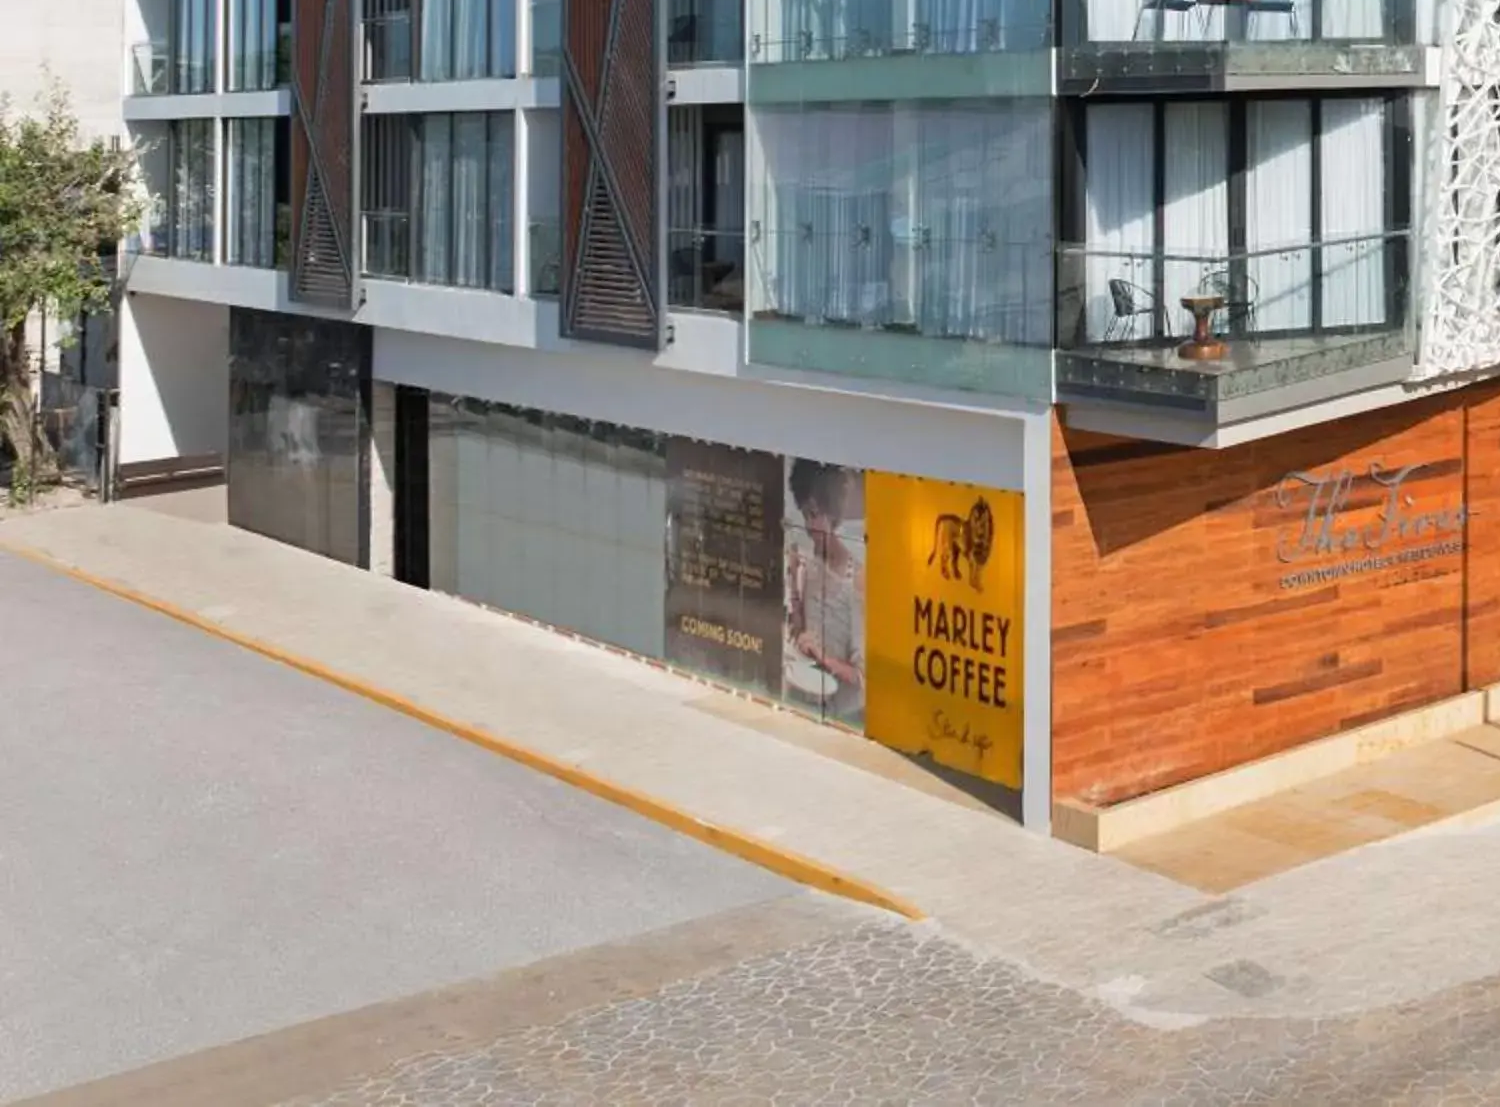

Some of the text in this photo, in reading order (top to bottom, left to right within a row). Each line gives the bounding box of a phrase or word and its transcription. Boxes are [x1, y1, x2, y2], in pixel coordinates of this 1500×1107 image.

[681, 615, 725, 643] COMING
[914, 595, 1010, 657] MARLEY
[914, 645, 1006, 708] COFFEE
